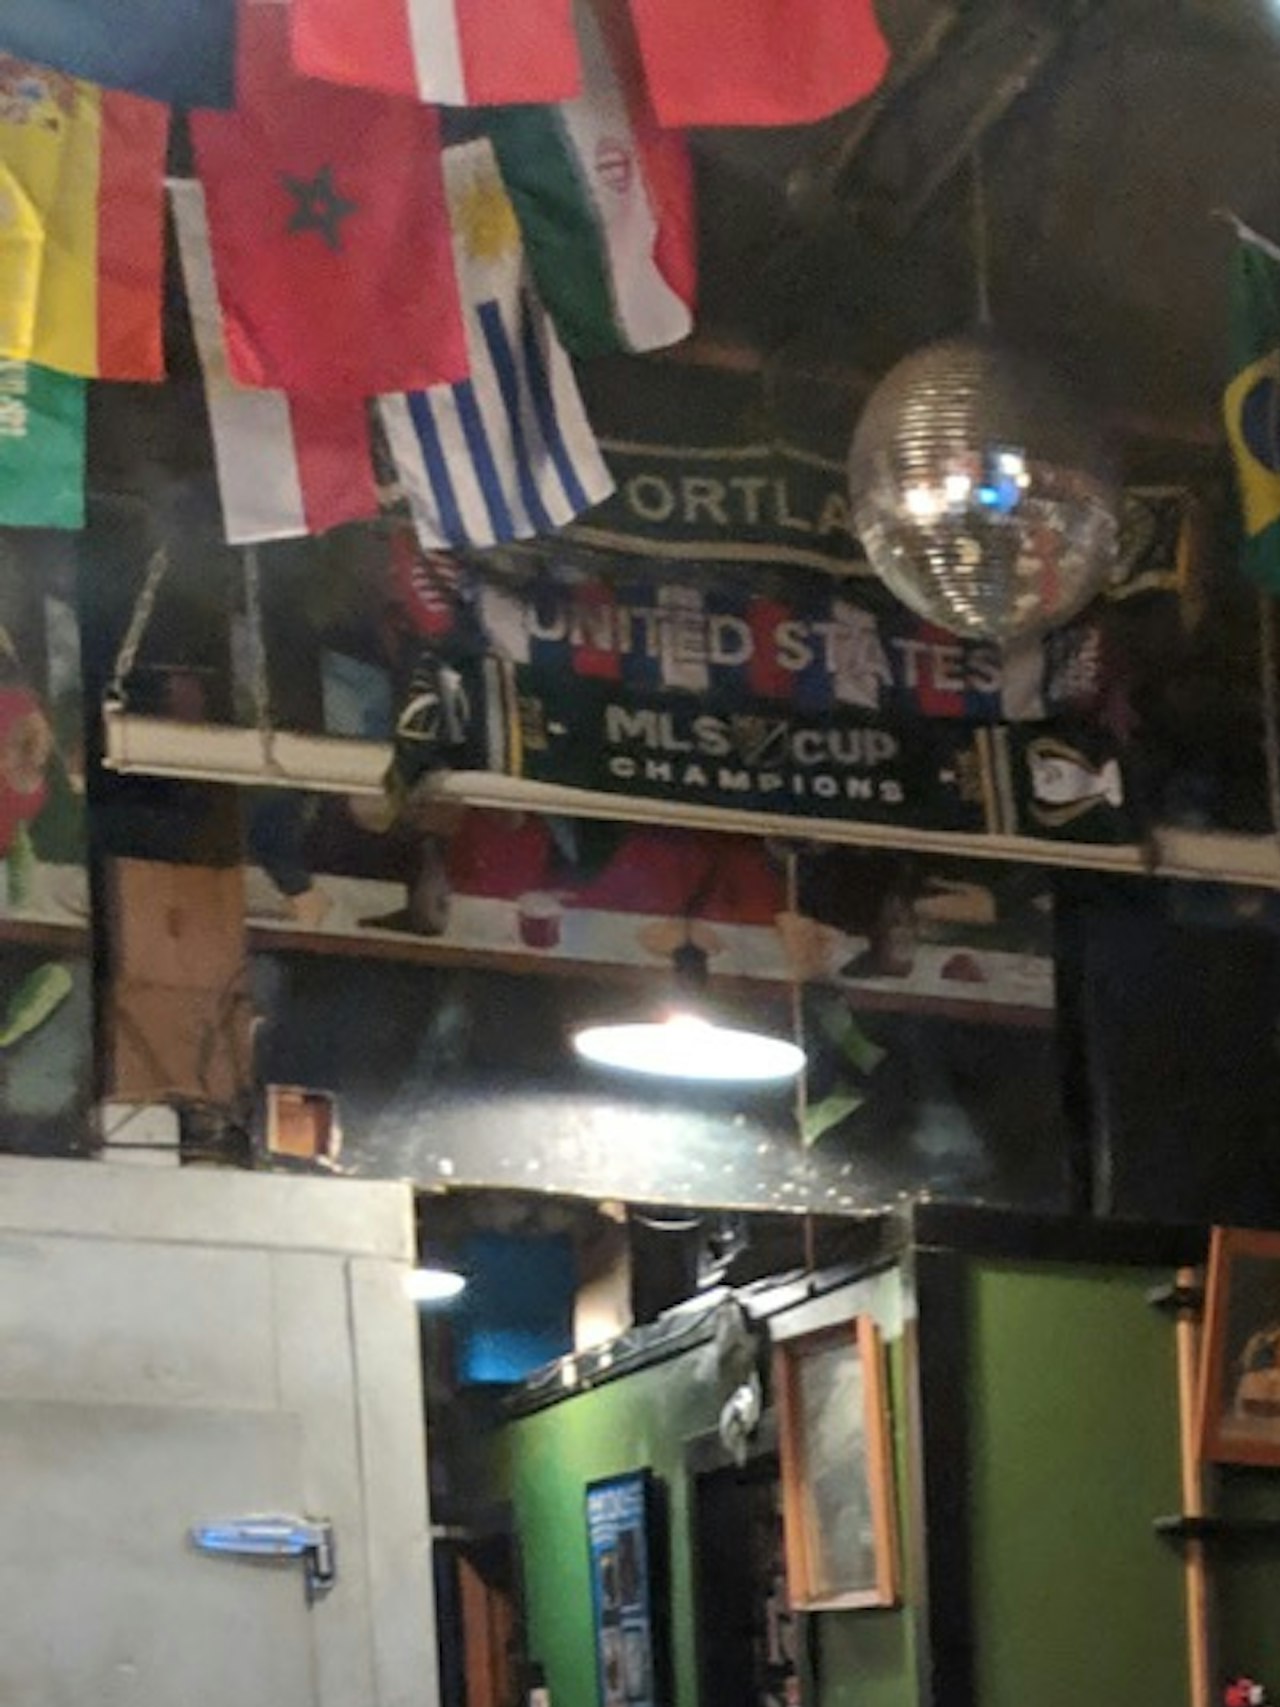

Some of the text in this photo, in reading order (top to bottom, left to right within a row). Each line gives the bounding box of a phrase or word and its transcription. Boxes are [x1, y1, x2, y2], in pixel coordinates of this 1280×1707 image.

[528, 600, 755, 665] UNITED
[775, 619, 1003, 694] STATES
[605, 707, 897, 766] MLS CUP
[609, 756, 905, 803] CHAMPIONS
